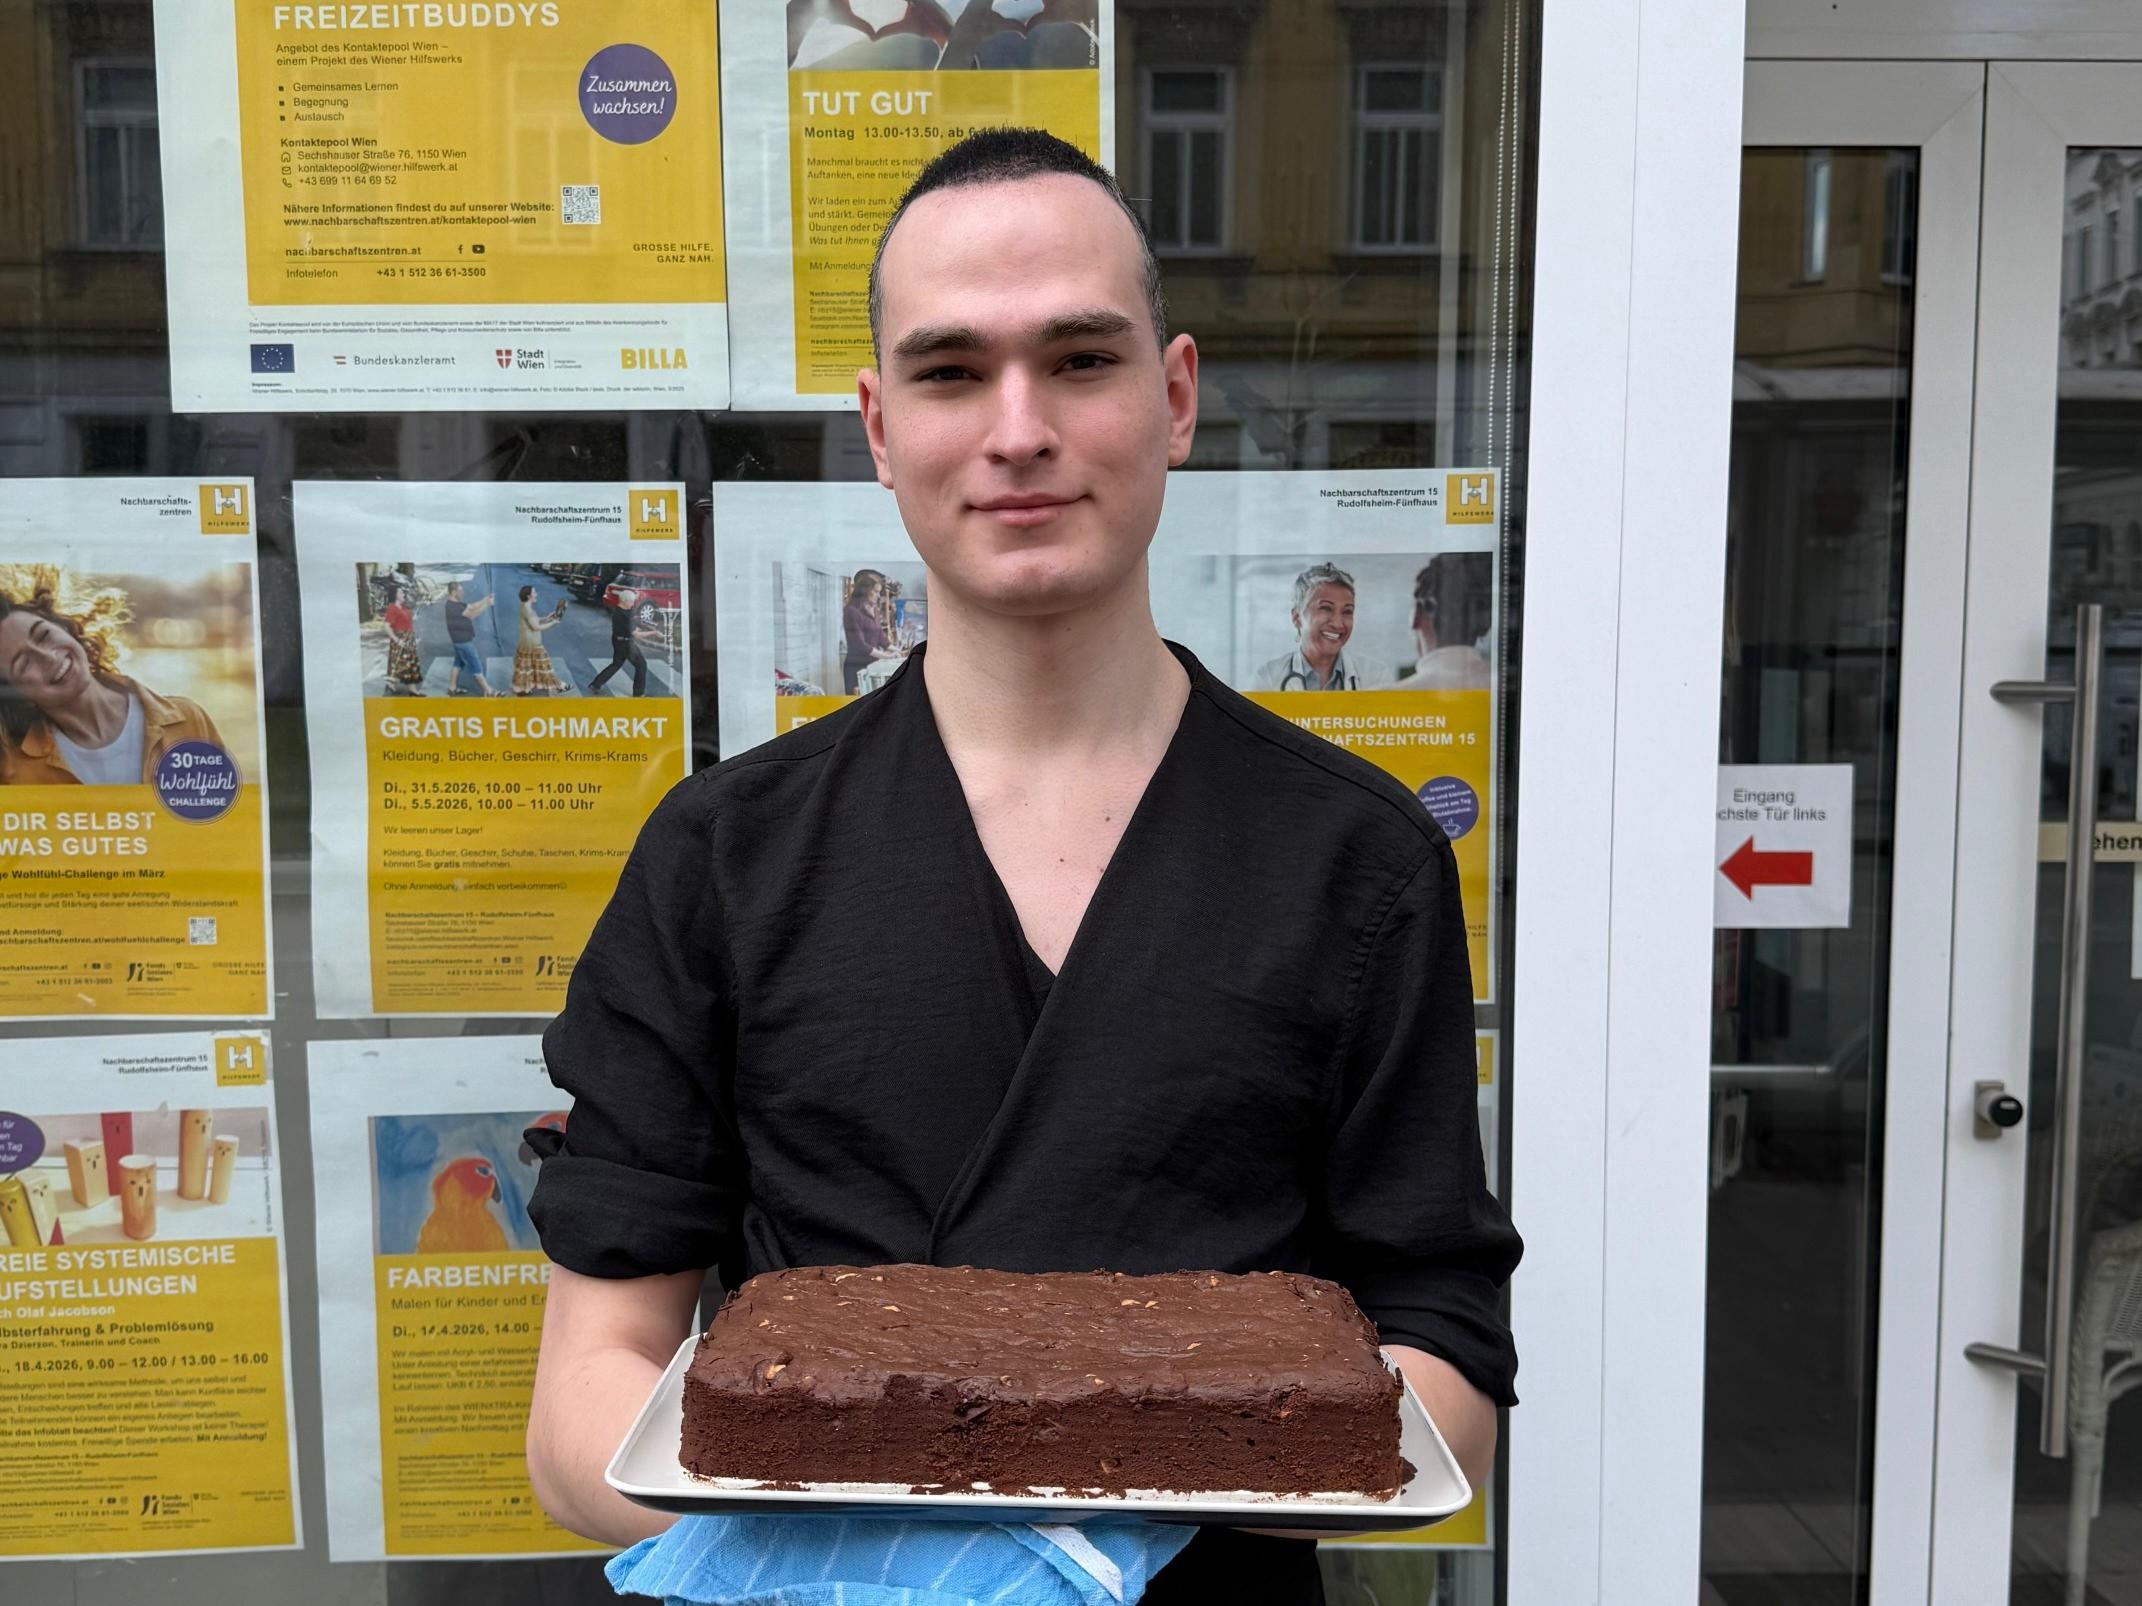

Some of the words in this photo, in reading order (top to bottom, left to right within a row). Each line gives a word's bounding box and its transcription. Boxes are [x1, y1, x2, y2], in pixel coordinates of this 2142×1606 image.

[274, 2, 559, 30] FREIZEITBUDDYS
[276, 43, 318, 55] Angebot
[321, 43, 340, 53] des
[343, 42, 410, 53] Kontaktepool
[412, 41, 439, 51] Wien
[276, 56, 307, 66] einem
[310, 55, 347, 68] Projekt
[349, 55, 368, 65] des
[370, 55, 407, 65] Wiener
[410, 54, 463, 64] Hilfswerks
[293, 82, 362, 92] Gemeinsames
[364, 82, 399, 91] Lernen
[586, 74, 673, 92] Zusammen
[293, 97, 349, 109] Begegnung
[593, 97, 665, 114] wachsen!
[802, 91, 861, 115] TUT
[870, 90, 933, 115] GUT
[294, 112, 345, 121] Austausch
[804, 126, 855, 141] Montag
[864, 126, 943, 139] 13.00-13.50,
[948, 127, 965, 139] ab
[280, 138, 349, 148] Kontaktepool
[351, 137, 378, 146] Wien
[297, 150, 360, 160] Sechshauser
[362, 150, 396, 160] Straße
[398, 149, 413, 159] 76,
[417, 149, 440, 159] 1150
[441, 149, 467, 158] Wien
[807, 157, 854, 166] Manchmal
[855, 157, 888, 166] braucht
[298, 162, 458, 174] kontaktepool@wiener.hilfswerk.at
[319, 176, 338, 186] 699
[341, 176, 351, 184] 11
[354, 175, 367, 185] 64
[369, 175, 382, 185] 69
[385, 175, 397, 185] 52
[808, 196, 824, 205] Wir
[825, 196, 850, 206] laden
[852, 196, 866, 206] ein
[868, 198, 887, 206] zum
[283, 204, 320, 213] Nähere
[322, 203, 393, 213] Informationen
[395, 203, 431, 212] findest
[433, 203, 447, 212] du
[449, 202, 466, 212] auf
[468, 204, 508, 212] unserer
[510, 202, 554, 212] Website:
[808, 210, 826, 219] und
[827, 209, 855, 219] stärkt.
[283, 215, 537, 226] www.nachbarschaftszentren.at/kontaktepool-wien
[808, 222, 848, 233] Übungen
[850, 223, 871, 232] oder
[633, 243, 676, 252] GROSSE
[680, 243, 714, 252] HILFE,
[657, 255, 685, 263] GANZ
[689, 254, 713, 263] NAH.
[286, 268, 338, 278] Infotelefon
[377, 268, 396, 277] +43
[399, 268, 404, 277] 1
[409, 268, 426, 277] 512
[430, 267, 442, 277] 36
[445, 267, 486, 277] 61-3500
[354, 354, 455, 366] Bundeskanzleramt
[517, 349, 544, 361] Stadt
[621, 348, 688, 370] BILLA
[517, 358, 545, 369] Wien
[1320, 488, 1425, 497] Nachbarschaftszentrum
[1428, 487, 1438, 496] 15
[120, 496, 192, 505] Nachbarschafts-
[1337, 498, 1438, 508] Rudolfsheim-Fünfhaus
[612, 506, 622, 514] 15
[380, 716, 483, 738] GRATIS
[493, 716, 668, 739] FLOHMARKT
[1458, 733, 1475, 745] 15
[171, 752, 193, 769] 30
[193, 755, 223, 766] TAGE
[383, 750, 443, 764] Kleidung,
[448, 750, 497, 762] Bücher,
[502, 750, 560, 762] Geschirr,
[565, 750, 648, 762] Krims-Krams
[159, 772, 236, 797] Wohlfühl
[384, 782, 406, 794] Di.,
[411, 782, 480, 795] 31.5.2026,
[485, 782, 521, 794] 10.00
[538, 782, 573, 794] 11.00
[578, 782, 602, 794] Uhr
[169, 797, 226, 807] CHALLENGE
[1733, 789, 1795, 806] Eingang
[384, 798, 407, 810] Di.,
[411, 798, 472, 811] 5.5.2026,
[477, 799, 513, 810] 10.00
[530, 799, 565, 810] 11.00
[570, 799, 594, 810] Uhr
[1716, 807, 1759, 821] chste
[1765, 807, 1789, 821] Tür
[1793, 808, 1826, 821] links
[4, 813, 47, 831] DIR
[56, 812, 155, 830] SELBST
[383, 826, 398, 834] Wir
[400, 826, 428, 834] leeren
[455, 826, 483, 836] Lager!
[62, 837, 147, 855] GUTES
[11, 870, 119, 881] Wohlfühl-Challenge
[138, 869, 165, 878] März
[56, 1245, 235, 1270] SYSTEMISCHE
[0, 1275, 197, 1300] UFSTELLUNGEN
[391, 1298, 431, 1309] Malen
[435, 1297, 452, 1308] für
[457, 1296, 498, 1308] Kinder
[503, 1296, 527, 1306] und
[16, 1306, 44, 1318] Olaf
[49, 1305, 115, 1317] Jacobson
[95, 1323, 105, 1335] &
[109, 1320, 214, 1335] Problemlösung
[392, 1325, 416, 1338] Di.,
[494, 1322, 530, 1334] 14.00
[60, 1338, 104, 1347] Trainerin
[107, 1338, 126, 1346] und
[128, 1336, 160, 1345] Coach
[15, 1359, 83, 1373] 18.4.2026,
[86, 1358, 115, 1370] 9.00
[132, 1356, 167, 1368] 12.00
[181, 1354, 216, 1366] 13.00
[233, 1352, 269, 1365] 16.00
